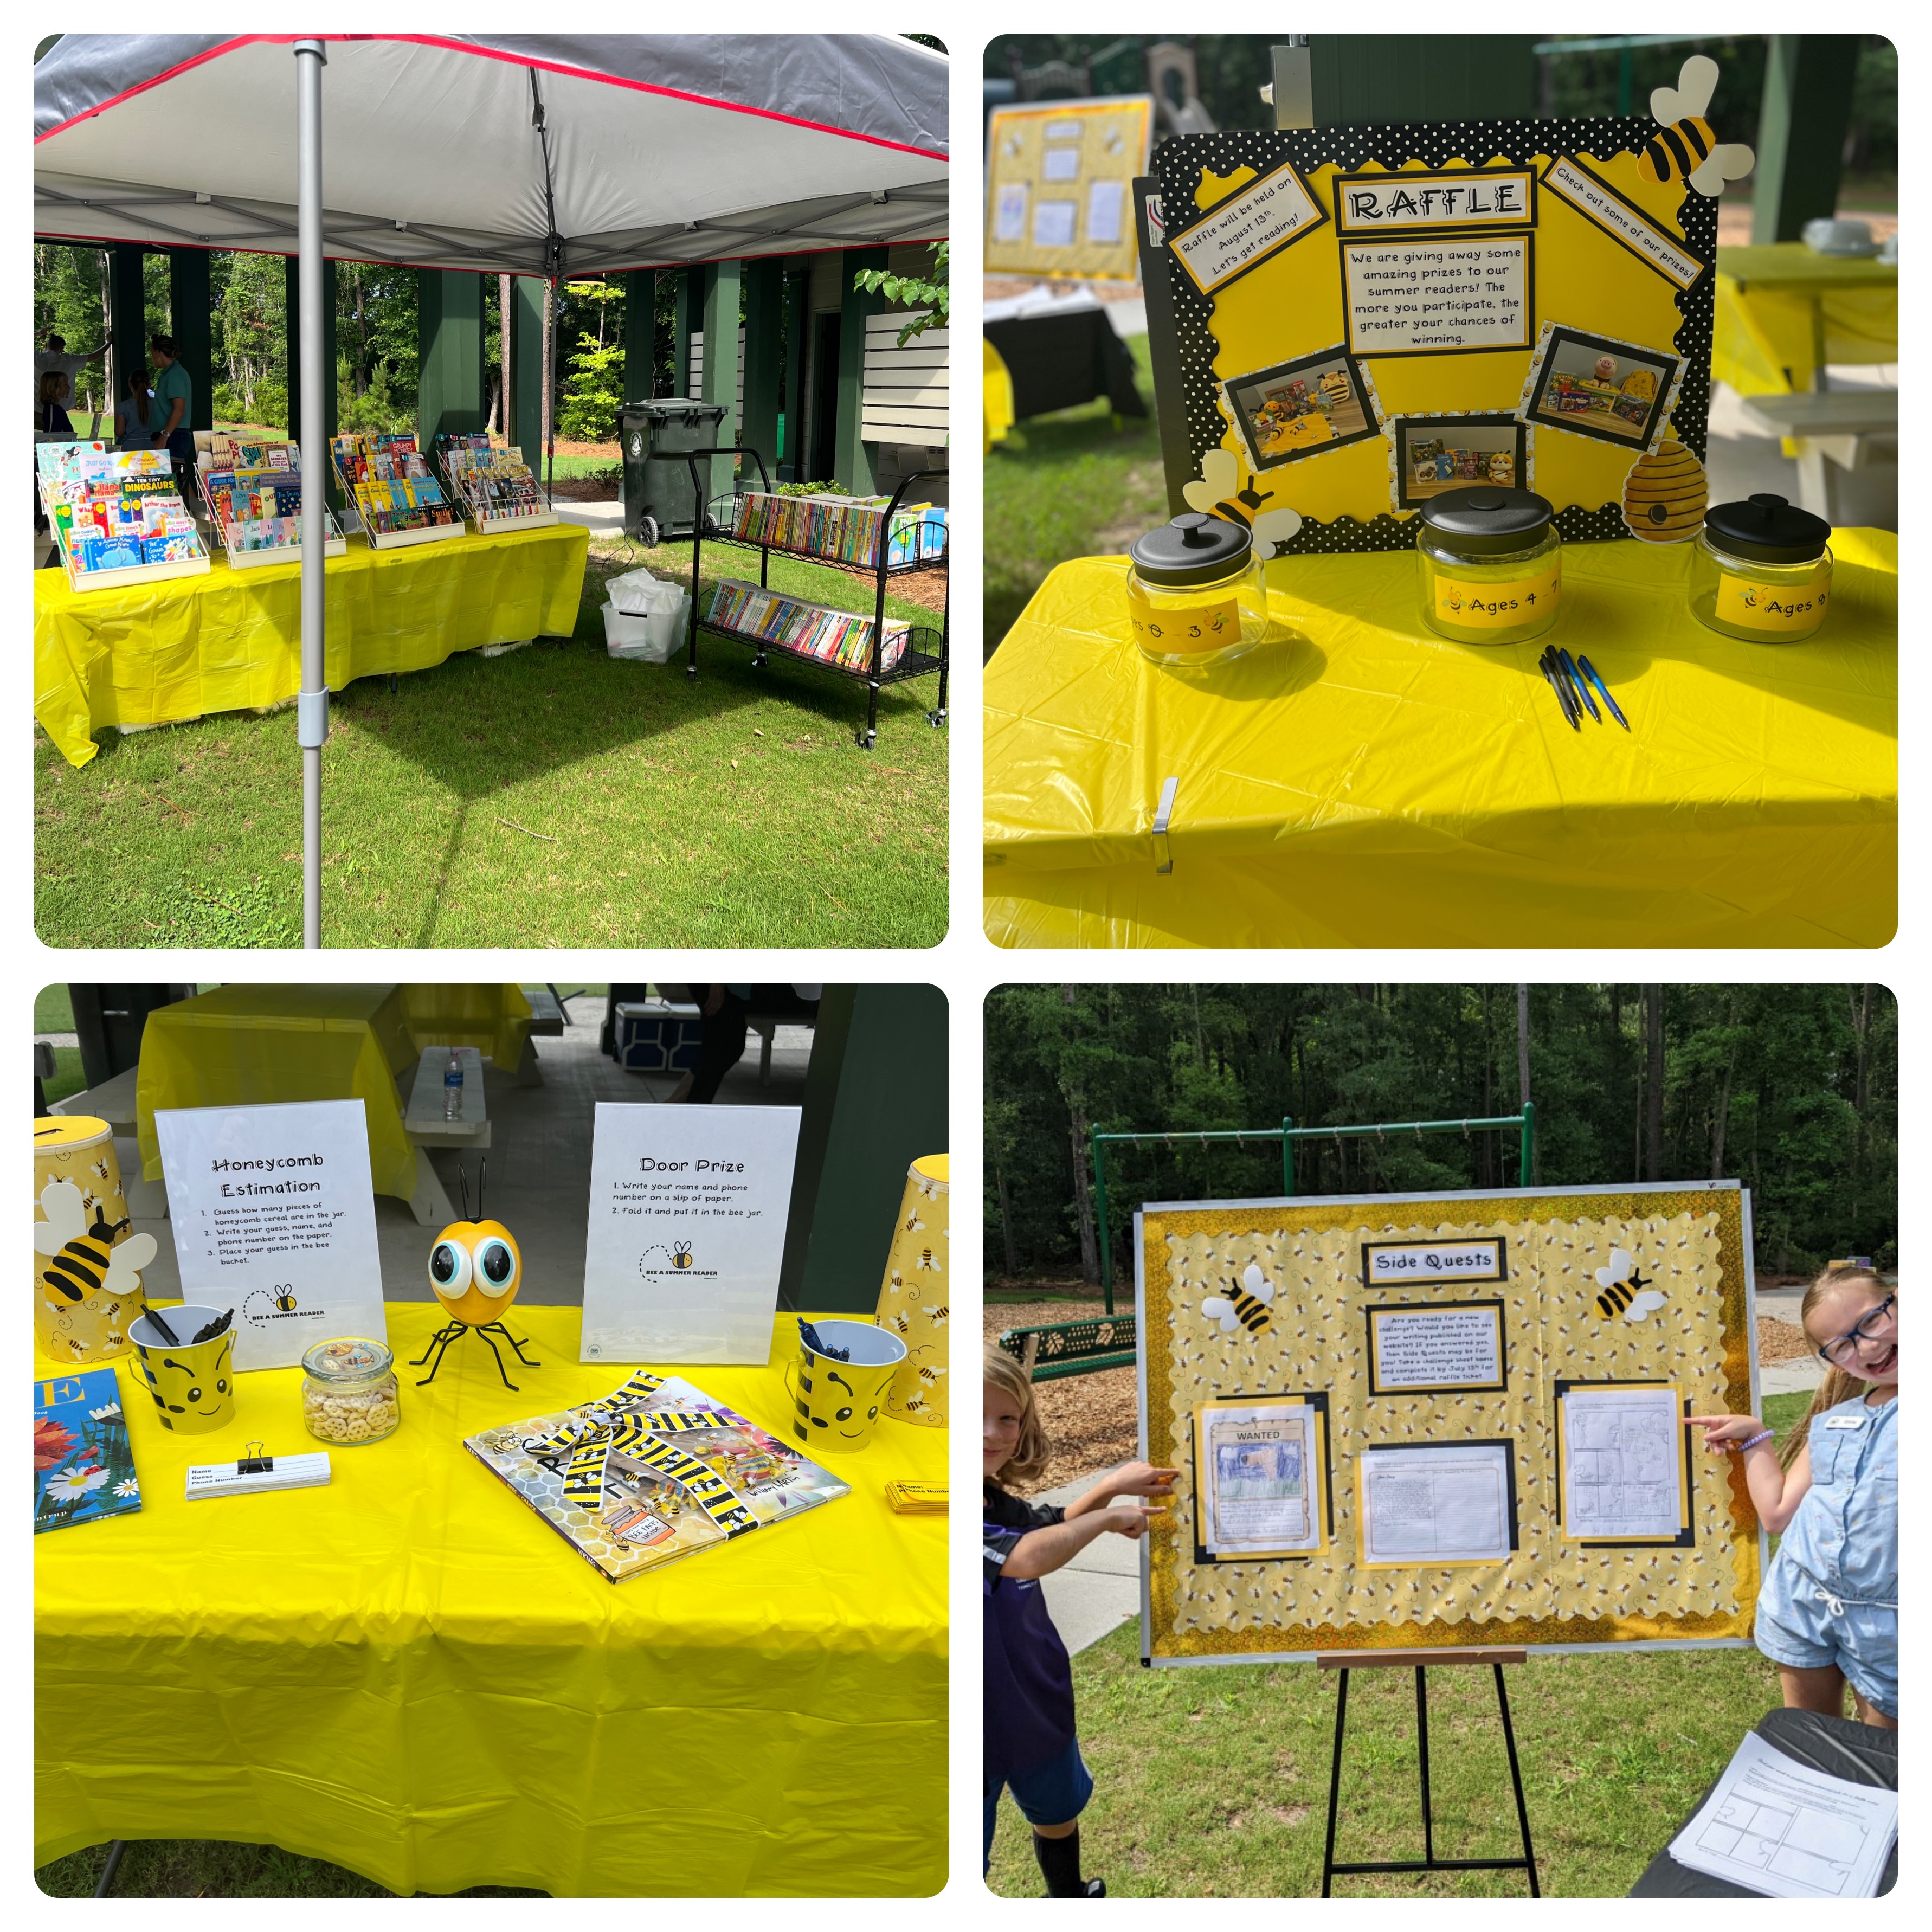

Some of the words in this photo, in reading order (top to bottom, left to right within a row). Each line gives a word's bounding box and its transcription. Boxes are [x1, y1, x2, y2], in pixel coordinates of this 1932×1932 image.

[1349, 185, 1522, 220] RAFFLE
[1181, 227, 1217, 253] Raffle
[1219, 212, 1239, 229] will
[1239, 204, 1252, 215] be
[1253, 188, 1275, 205] held
[1278, 178, 1291, 190] on
[1557, 168, 1584, 192] Check
[1587, 192, 1603, 207] out
[1604, 205, 1628, 228] some
[1630, 228, 1643, 237] of
[1644, 239, 1660, 252] our
[1659, 252, 1695, 278] prizes!
[1212, 256, 1238, 275] Let's
[1241, 242, 1256, 258] get
[1258, 213, 1299, 244] reading!
[1219, 223, 1253, 250] August
[1351, 253, 1371, 263] We
[1377, 254, 1399, 262] are
[1403, 252, 1443, 265] giving
[1448, 251, 1480, 261] away
[1486, 249, 1521, 258] some
[1363, 270, 1416, 281] amazing
[1421, 267, 1462, 280] prizes
[1468, 267, 1480, 276] to
[1486, 266, 1509, 275] our
[1368, 287, 1419, 297] summer
[1425, 283, 1479, 294] readers!
[1485, 283, 1505, 292] The
[1355, 304, 1389, 313] more
[1394, 304, 1418, 314] you
[1422, 300, 1496, 314] participate,
[1501, 299, 1519, 307] the
[1360, 320, 1407, 332] greater
[1413, 319, 1443, 329] your
[1448, 316, 1496, 326] chances
[1500, 314, 1515, 324] of
[1411, 336, 1465, 345] winning.
[125, 481, 174, 492] DINOSAURS
[432, 508, 453, 517] Smile!
[1468, 598, 1518, 615] Ages
[1525, 593, 1536, 605] 4
[1551, 579, 1557, 593] 7
[1765, 600, 1812, 617] Ages
[1188, 625, 1201, 638] 3
[211, 1154, 323, 1172] Honeycomb
[640, 1158, 688, 1171] Door
[695, 1160, 744, 1173] Prize
[221, 1181, 320, 1197] Estimation
[672, 1194, 688, 1203] slip
[215, 1216, 261, 1226] honeycomb
[332, 1211, 346, 1220] jar.
[746, 1209, 763, 1218] jar.
[217, 1238, 242, 1247] phone
[307, 1232, 332, 1240] paper.
[245, 1247, 264, 1255] your
[267, 1245, 288, 1253] guess
[221, 1257, 249, 1265] bucket.
[1376, 1254, 1417, 1268] Side
[1425, 1253, 1492, 1270] Quests
[1237, 1431, 1280, 1440] WANTED
[628, 1529, 642, 1539] BEE
[642, 1520, 659, 1531] FACTS
[578, 1548, 596, 1567] VIKING
